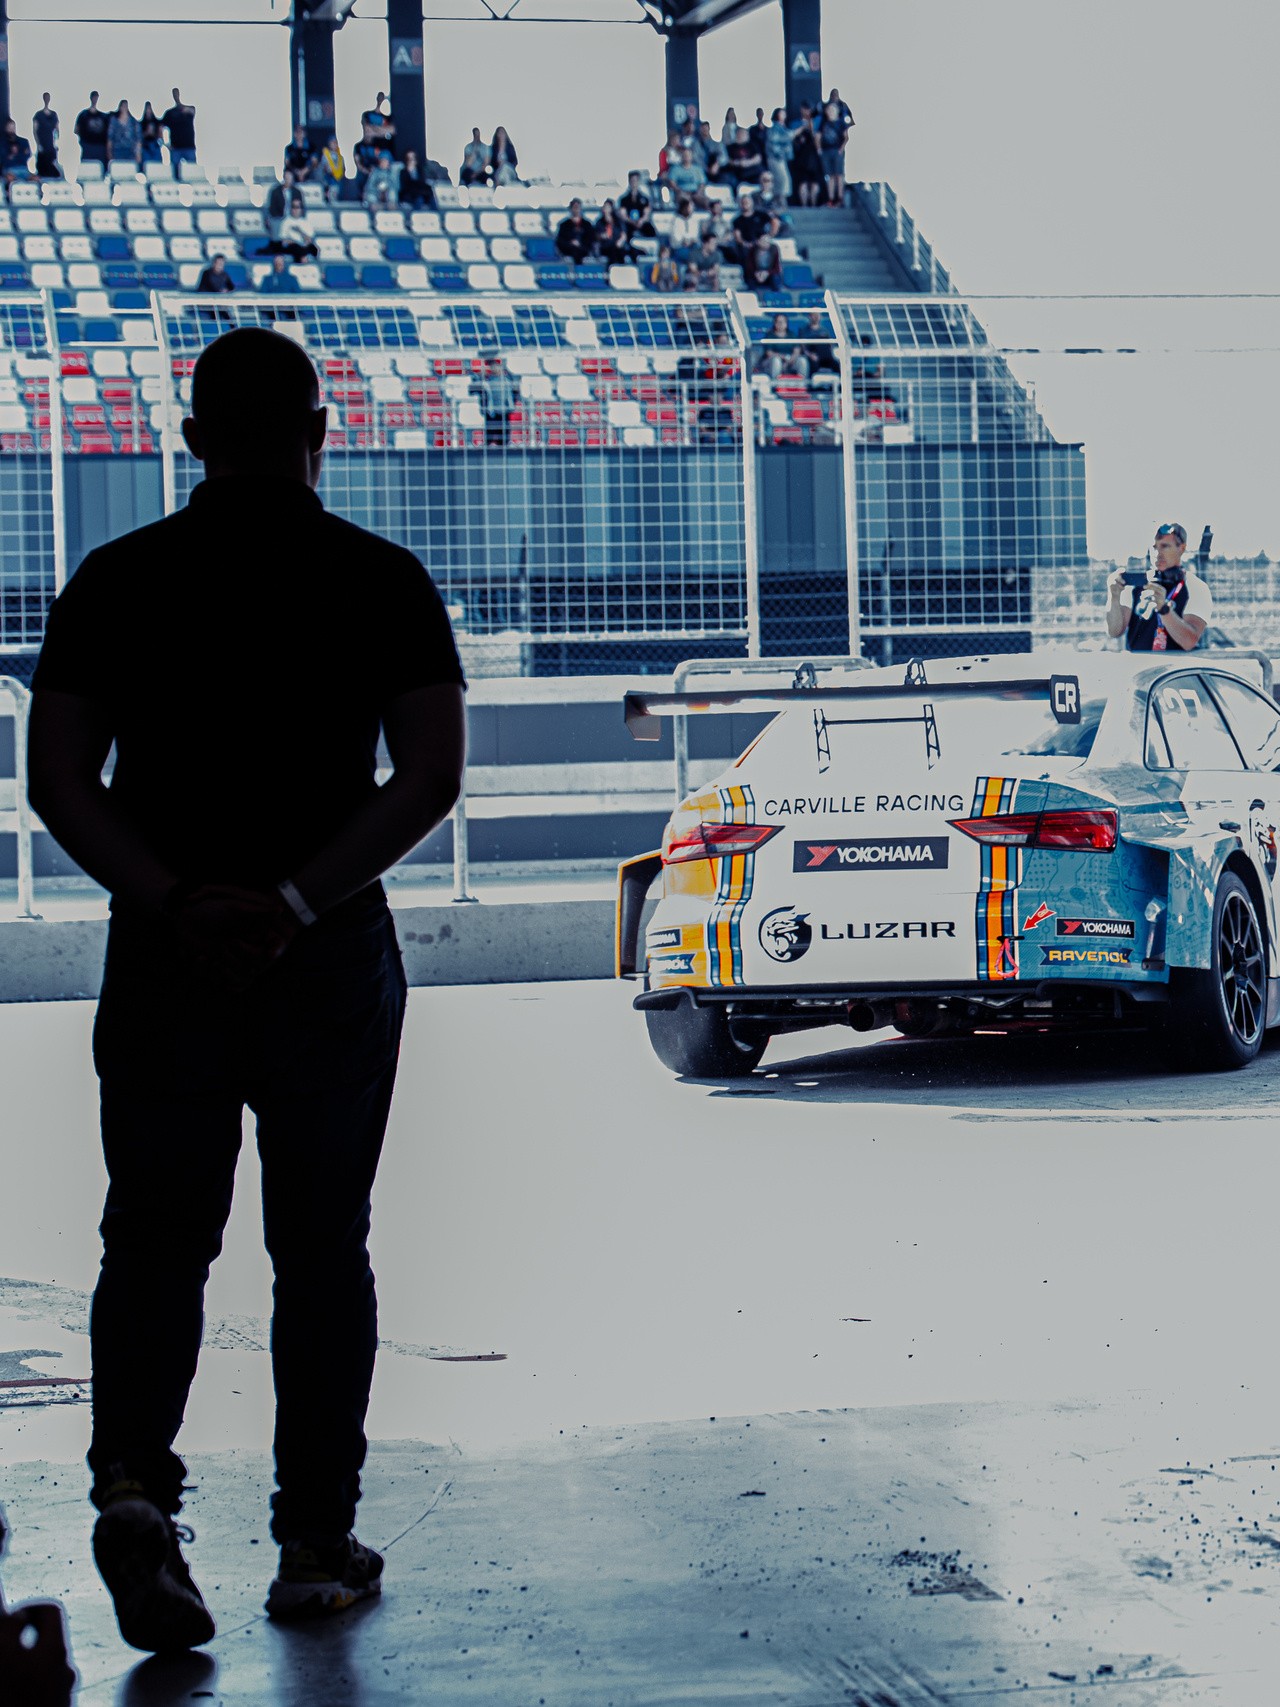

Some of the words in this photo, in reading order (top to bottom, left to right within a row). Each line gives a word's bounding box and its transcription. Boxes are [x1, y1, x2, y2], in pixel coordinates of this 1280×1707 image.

[1054, 682, 1077, 713] CR
[764, 796, 866, 816] CARVILLE
[876, 794, 964, 812] RACING
[836, 845, 934, 864] YOKOHAMA
[821, 921, 956, 940] LUZAR
[1082, 922, 1132, 935] YOKOHAMA
[1048, 950, 1128, 964] RAVENOL
